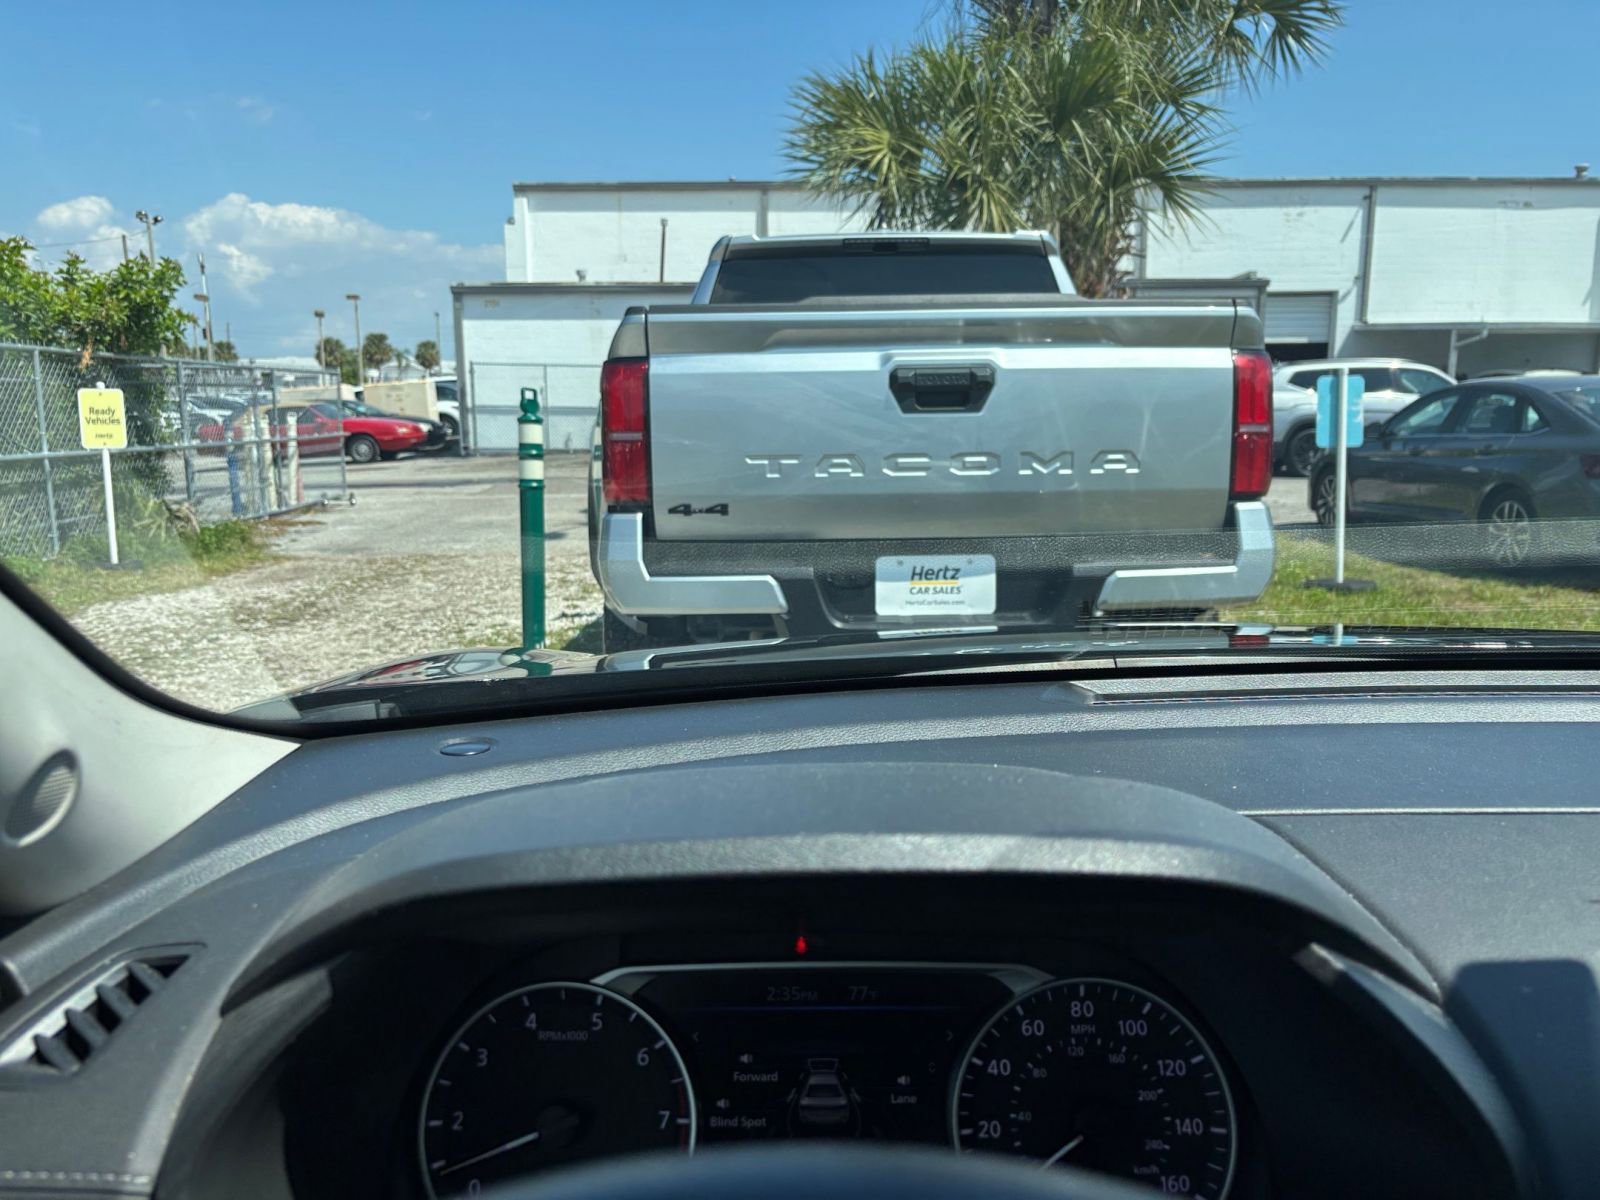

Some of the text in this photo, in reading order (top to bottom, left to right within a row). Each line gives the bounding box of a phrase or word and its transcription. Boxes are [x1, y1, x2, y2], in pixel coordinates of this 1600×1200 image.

[89, 407, 116, 417] Ready
[85, 417, 120, 425] Vehicles
[745, 450, 1140, 478] TACOMA
[911, 565, 961, 581] Hertz
[909, 586, 961, 595] CAR SALES
[1071, 1001, 1094, 1017] 80
[525, 1013, 537, 1030] 4
[592, 1013, 602, 1030] 5
[1022, 1020, 1044, 1036] 60
[1071, 1024, 1095, 1034] MPH
[1119, 1020, 1147, 1036] 100
[477, 1049, 488, 1066] 3
[637, 1048, 649, 1065] 6
[1069, 1046, 1084, 1056] 120
[1109, 1053, 1125, 1064] 160
[988, 1059, 1011, 1075] 40
[1033, 1067, 1047, 1078] 80
[1158, 1060, 1186, 1076] 120
[733, 1072, 778, 1082] Forward
[891, 1094, 917, 1104] Lane
[1138, 1090, 1157, 1101] 200
[452, 1111, 463, 1130] 2
[659, 1111, 669, 1128] 7
[710, 1116, 766, 1130] Blind Spot
[1017, 1111, 1032, 1122] 40
[978, 1121, 1001, 1138] 20
[1175, 1118, 1203, 1135] 140
[1145, 1139, 1163, 1150] 240
[1134, 1164, 1159, 1174] km/h
[1160, 1175, 1190, 1192] 160
